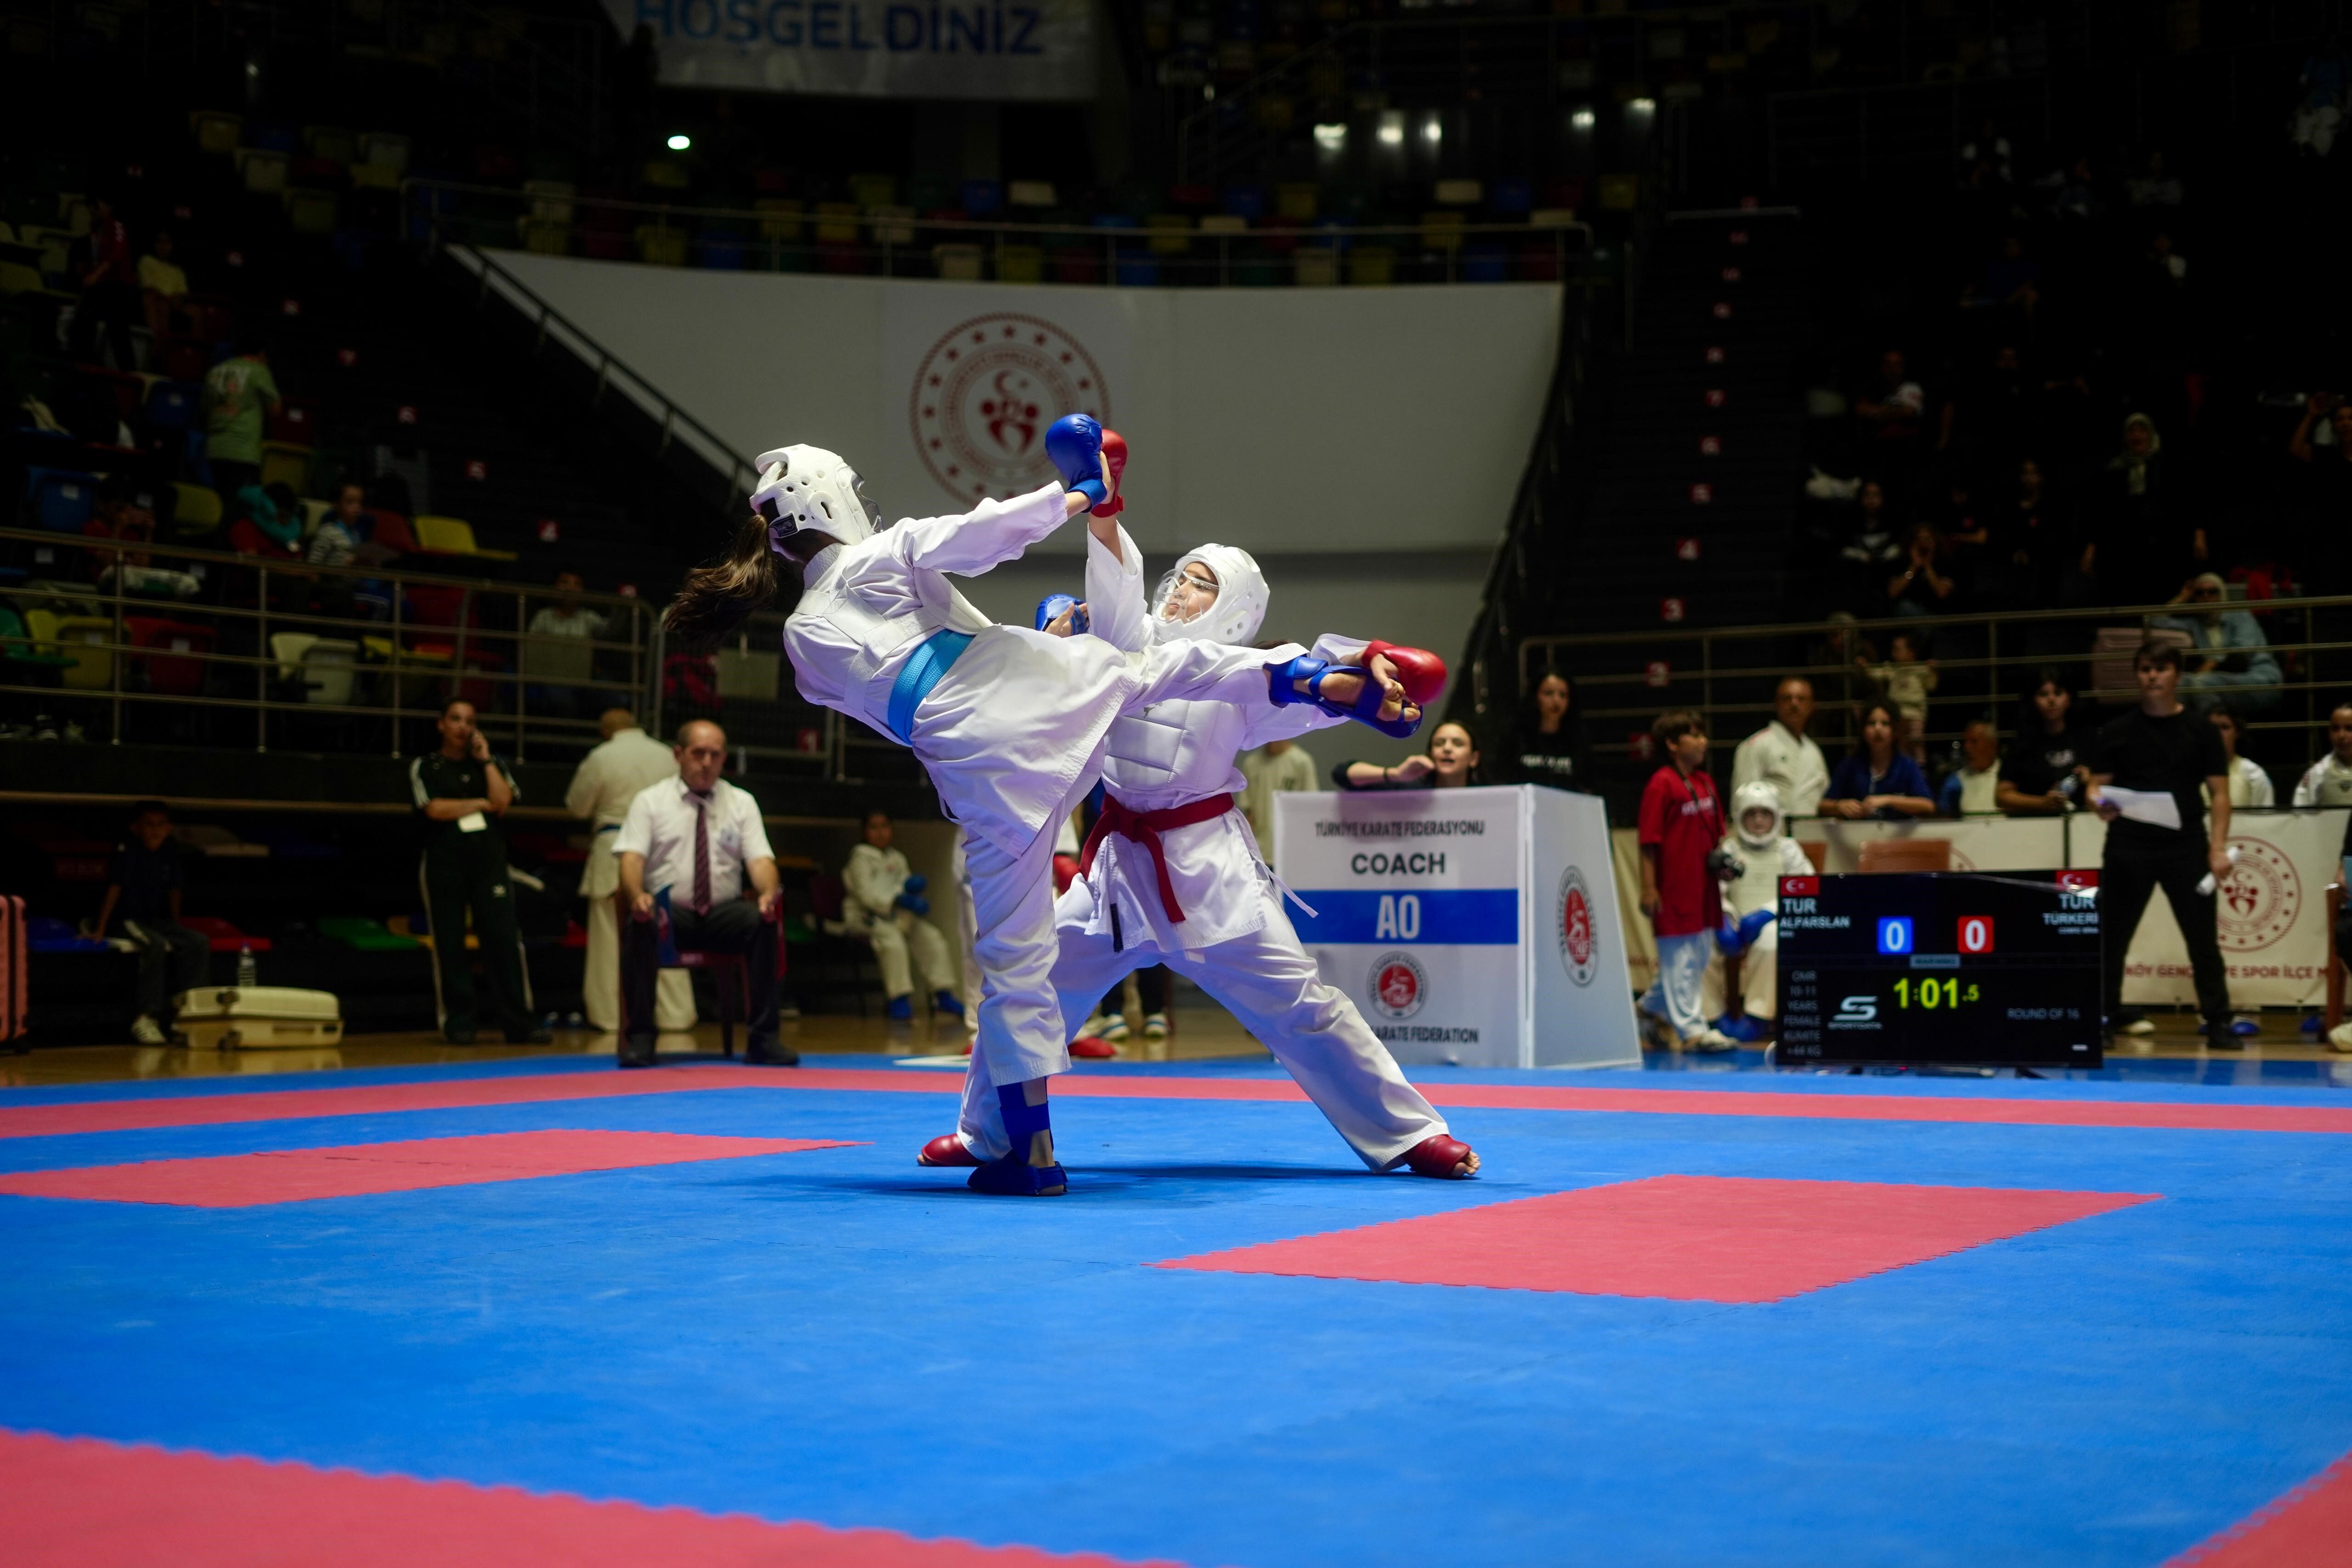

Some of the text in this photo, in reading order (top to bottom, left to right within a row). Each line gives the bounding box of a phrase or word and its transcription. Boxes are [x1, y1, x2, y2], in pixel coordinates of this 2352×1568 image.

[636, 0, 1042, 54] HOŞGELDİNİZ
[1316, 819, 1485, 837] TÜRKİYE KARATE FEDERASYONU
[1352, 853, 1445, 874] COACH
[1782, 898, 1817, 914] TUR
[1375, 894, 1421, 938] AO
[1780, 916, 1850, 928] ALPARSLAN
[2042, 911, 2099, 925] TÜRKERİ
[1886, 921, 1905, 951] 0
[1964, 919, 1986, 952] 0
[2242, 966, 2279, 979] SPOR
[2284, 963, 2314, 980] İLÇE
[1787, 1000, 1819, 1013] YEARS
[2007, 1008, 2081, 1020] ROUND OF 16
[1783, 1014, 1823, 1028] FEMALE
[1371, 1025, 1478, 1043] ARATE FEDERATION
[1783, 1030, 1821, 1042] KUMITE
